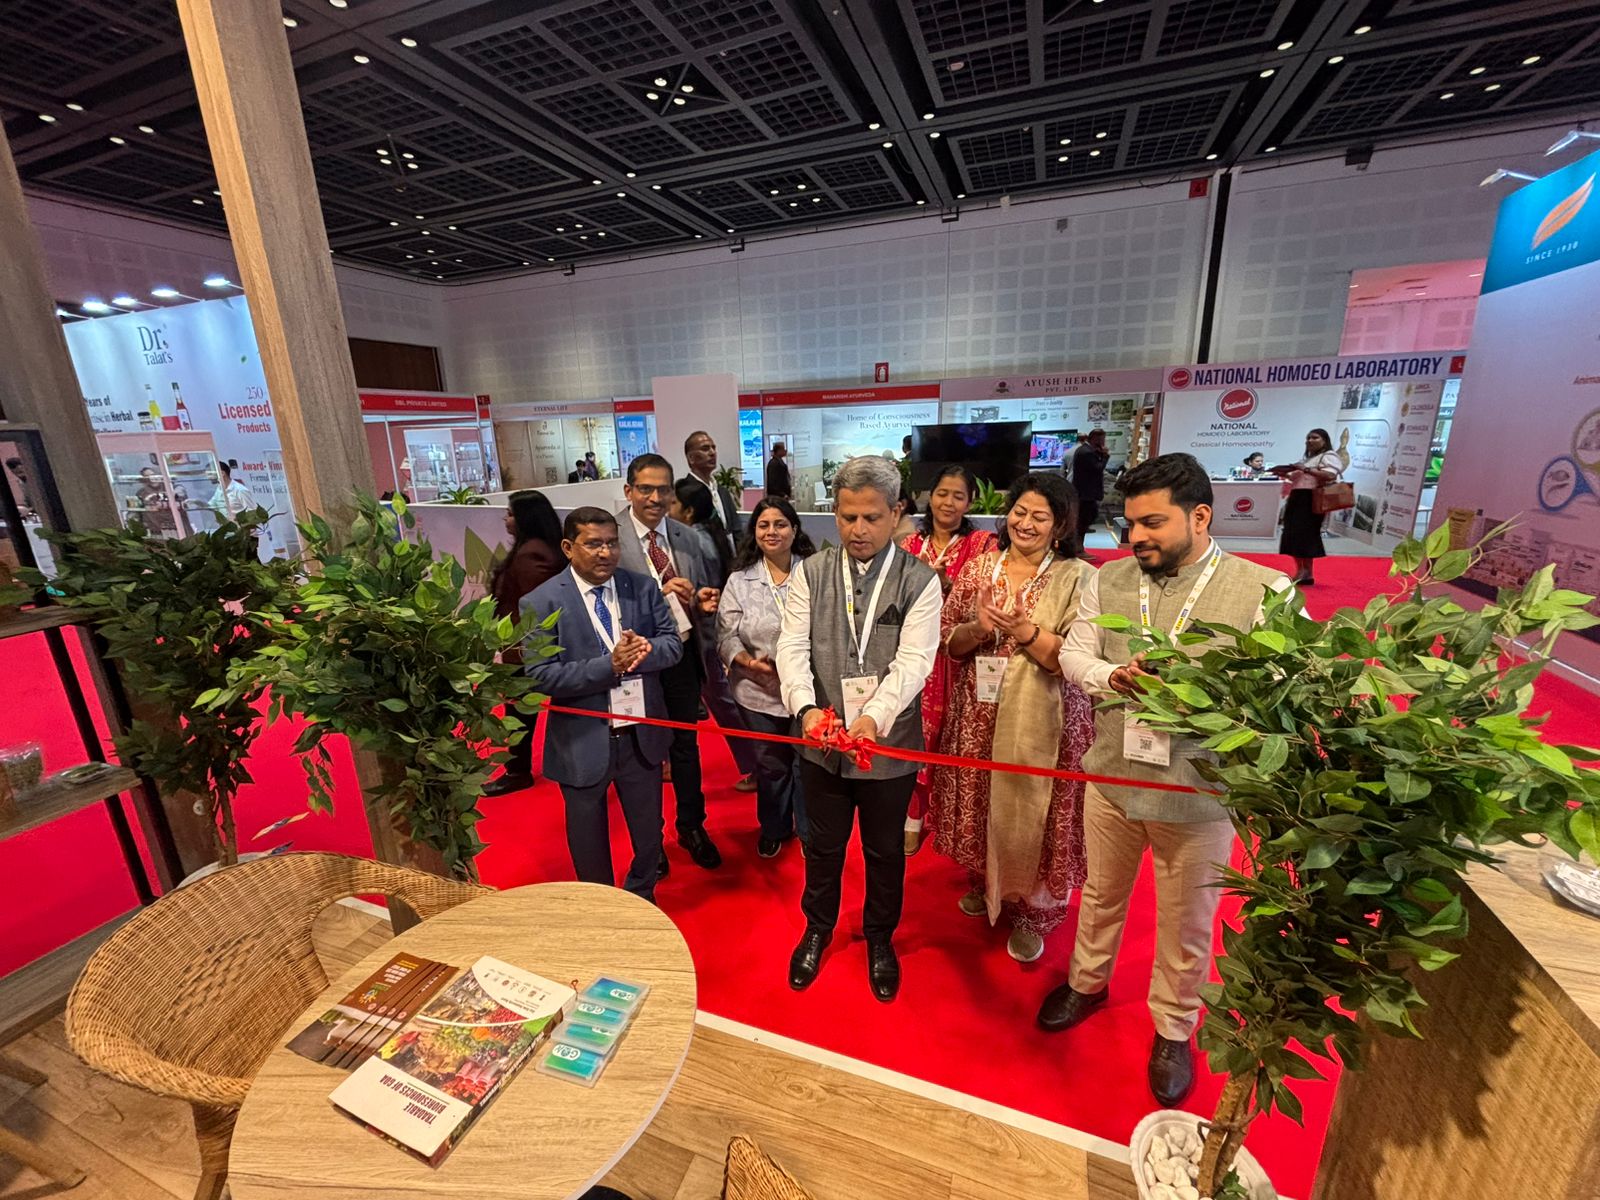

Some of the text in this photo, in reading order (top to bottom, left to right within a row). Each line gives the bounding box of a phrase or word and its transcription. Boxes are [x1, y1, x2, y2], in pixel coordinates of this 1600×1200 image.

[1525, 241, 1579, 264] SINCE 1930
[1194, 357, 1442, 386] NATIONAL HOMOEO LABORATORY
[1024, 375, 1103, 387] AYUSH HERBS
[246, 387, 264, 399] 250
[104, 395, 111, 406] of
[111, 410, 134, 422] Herbal
[218, 400, 272, 420] Licensed
[847, 412, 931, 422] Home of Consciousness
[237, 423, 272, 434] Products
[859, 421, 881, 430] Based
[1222, 439, 1276, 448] Homoeopathy
[380, 1074, 447, 1114] BIORESOURCES OF GOA
[403, 1102, 437, 1124] TRADABLE
